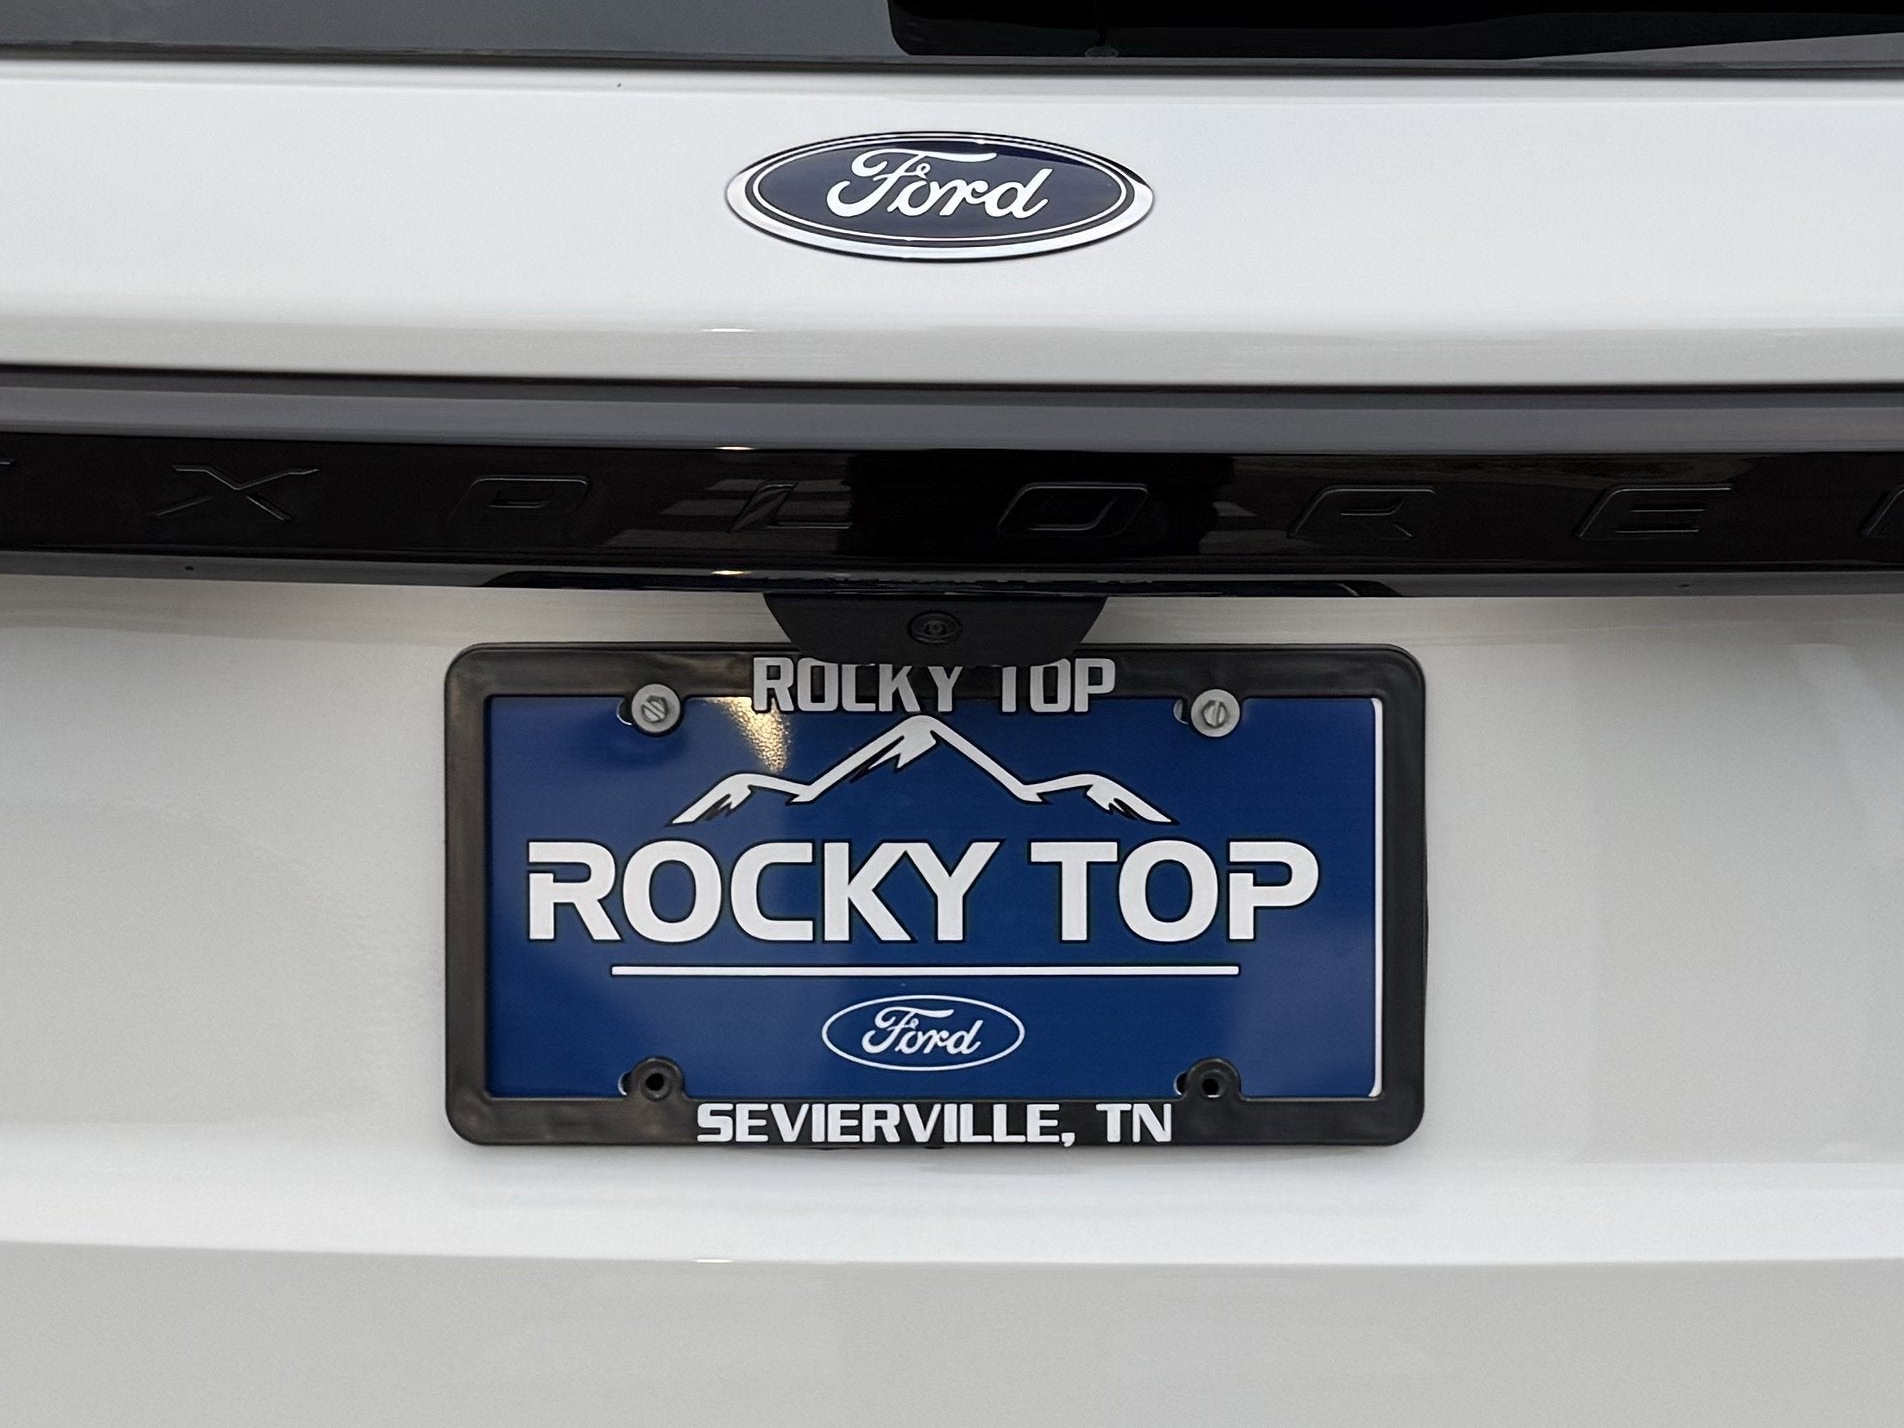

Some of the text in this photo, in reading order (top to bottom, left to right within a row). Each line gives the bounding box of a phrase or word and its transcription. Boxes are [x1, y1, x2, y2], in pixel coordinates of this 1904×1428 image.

[825, 147, 1053, 220] Ford
[752, 656, 1116, 713] ROCKY TOP
[526, 839, 1321, 943] ROCKY TOP
[860, 1005, 983, 1058] Ford
[696, 1102, 1173, 1148] SEVIERVILLE, TN
